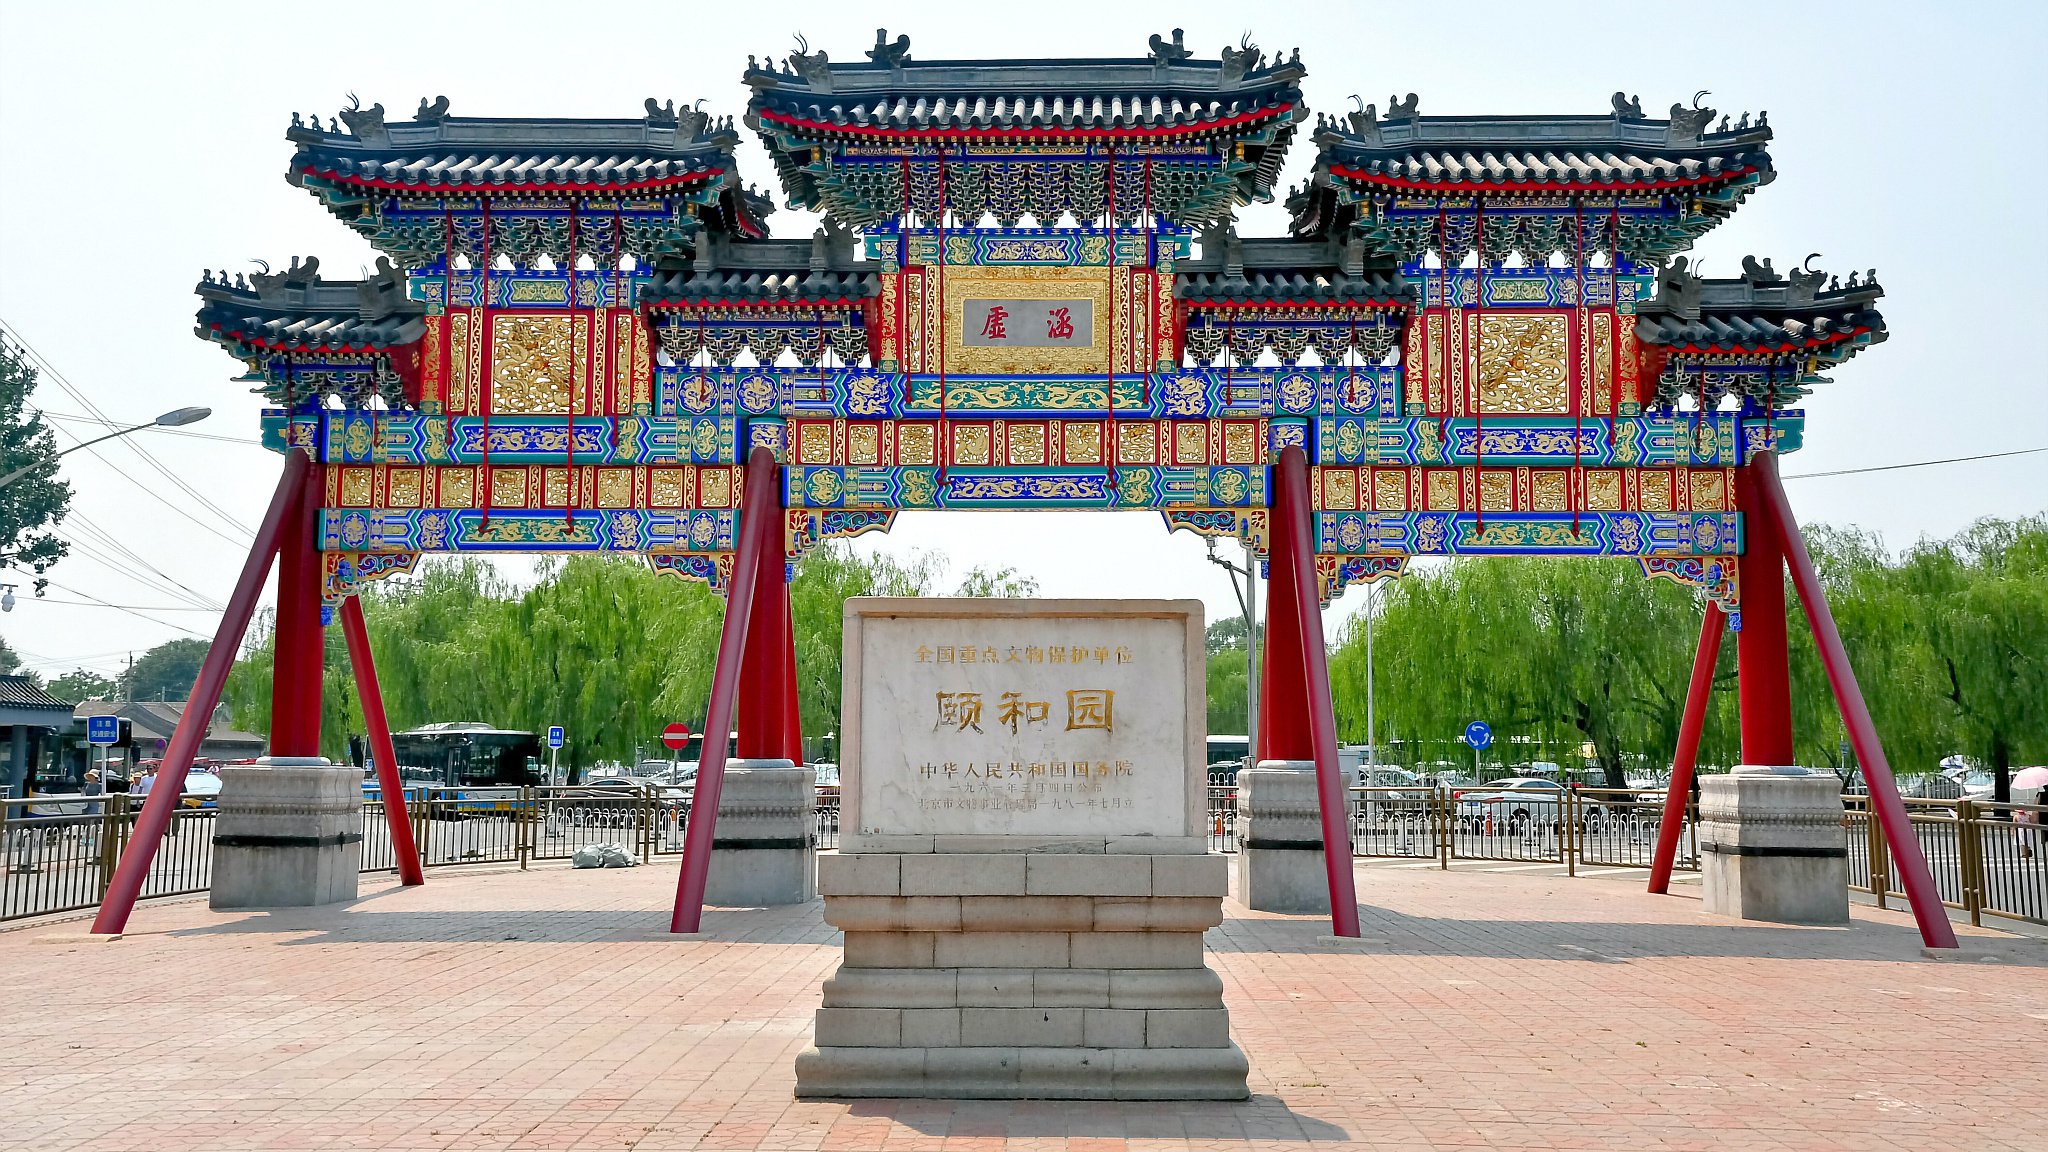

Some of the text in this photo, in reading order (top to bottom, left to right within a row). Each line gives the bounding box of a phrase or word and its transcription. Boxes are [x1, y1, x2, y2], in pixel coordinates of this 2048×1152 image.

[914, 644, 1134, 665] 全国重点文物保护单位
[933, 689, 1116, 737] 颐和园
[920, 760, 1134, 779] 中华人民共和国国务院
[949, 781, 1103, 794] 一九六一年三月四日公布
